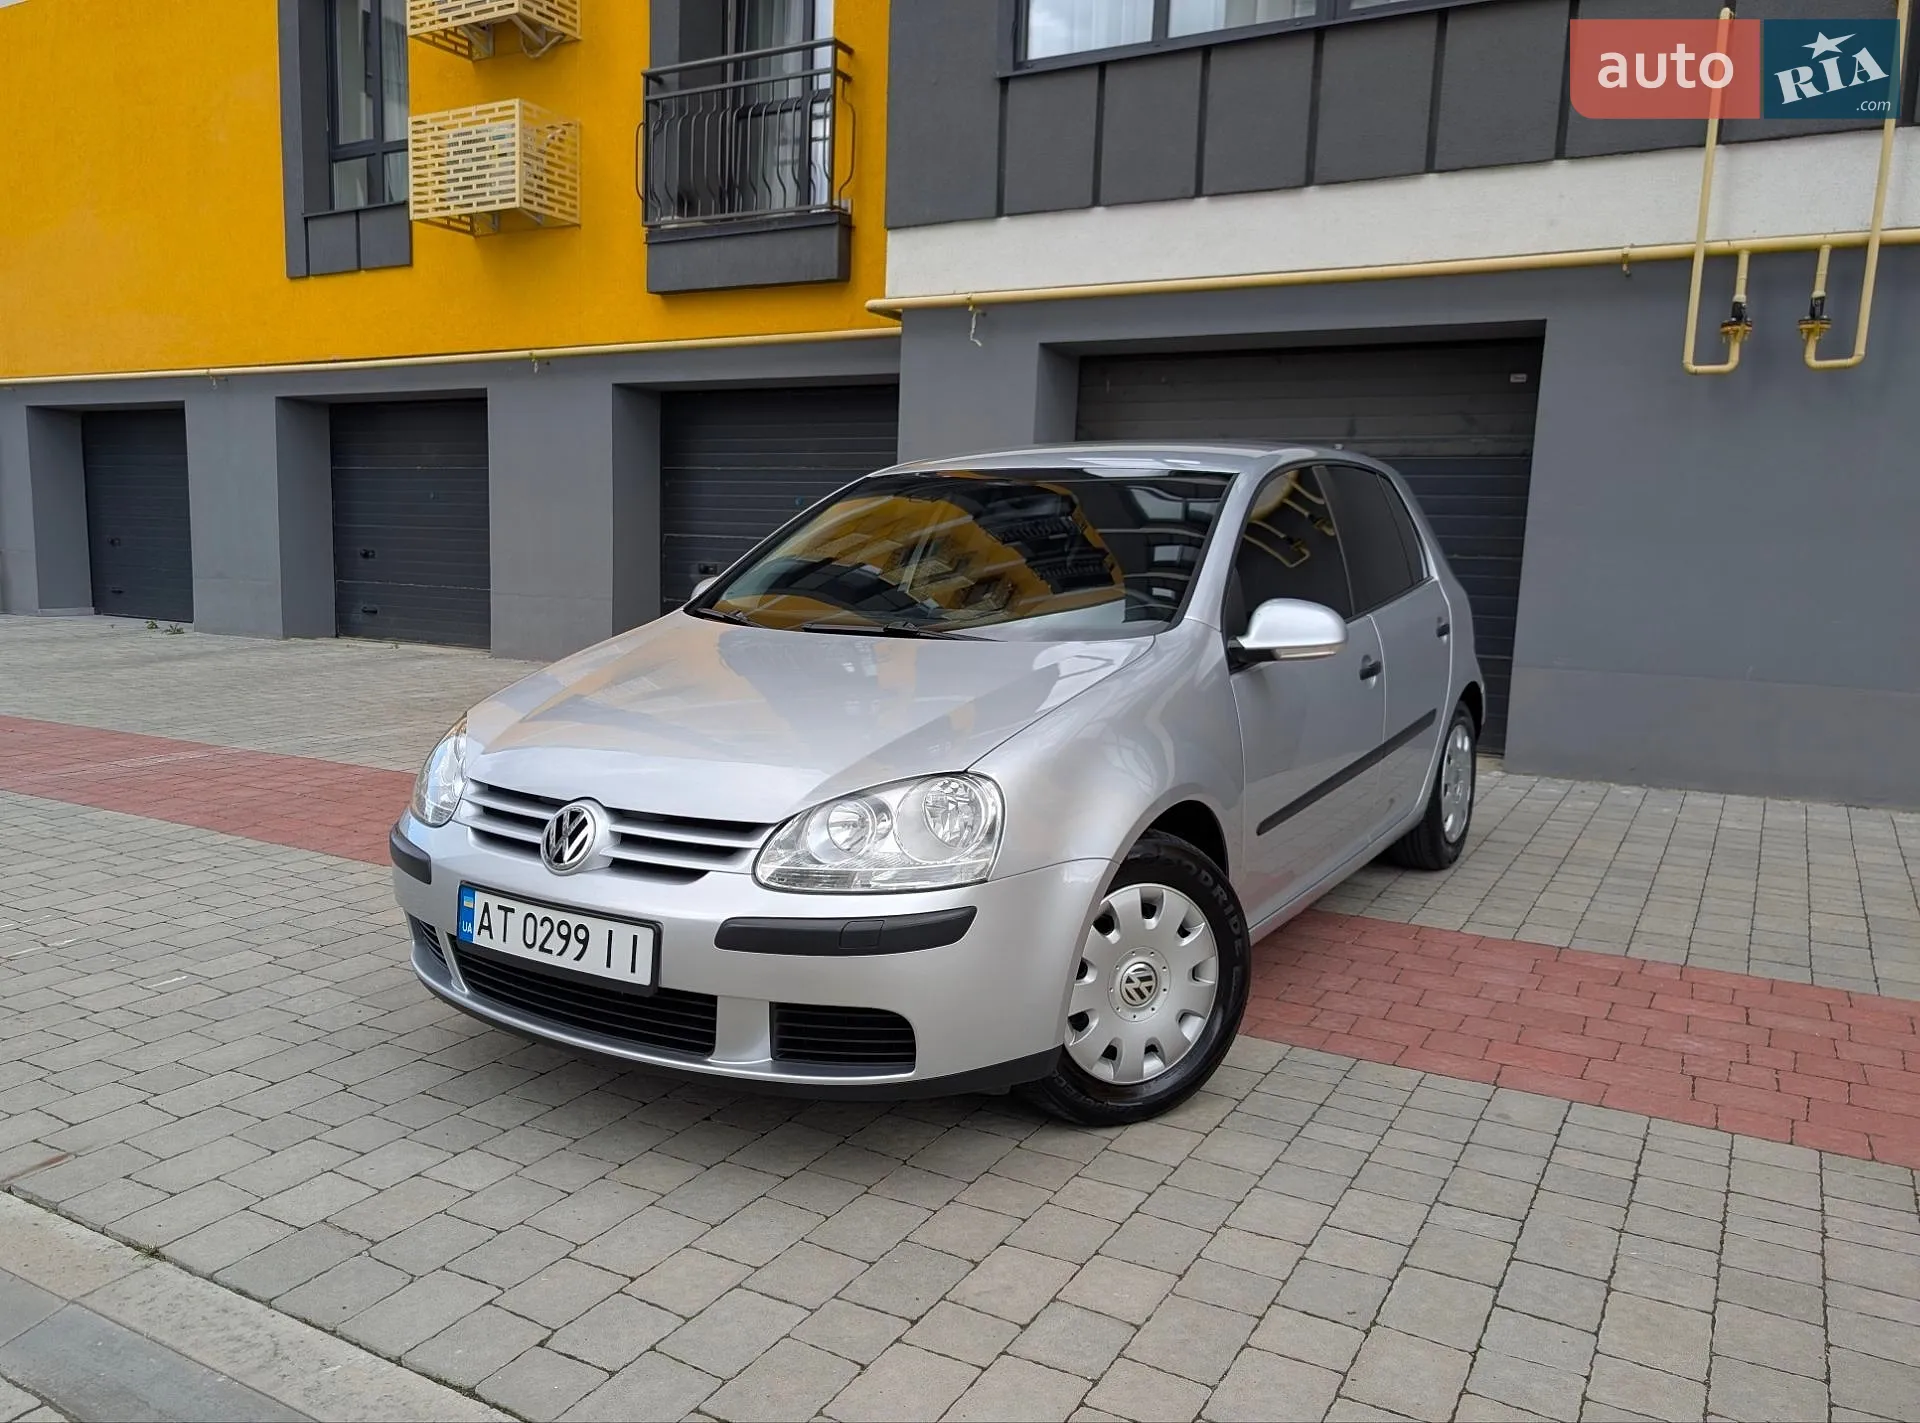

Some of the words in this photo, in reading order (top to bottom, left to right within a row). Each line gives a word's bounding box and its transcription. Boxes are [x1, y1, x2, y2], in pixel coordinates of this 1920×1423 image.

[462, 922, 473, 934] UA
[477, 901, 515, 943] AT
[522, 912, 590, 962] 0299
